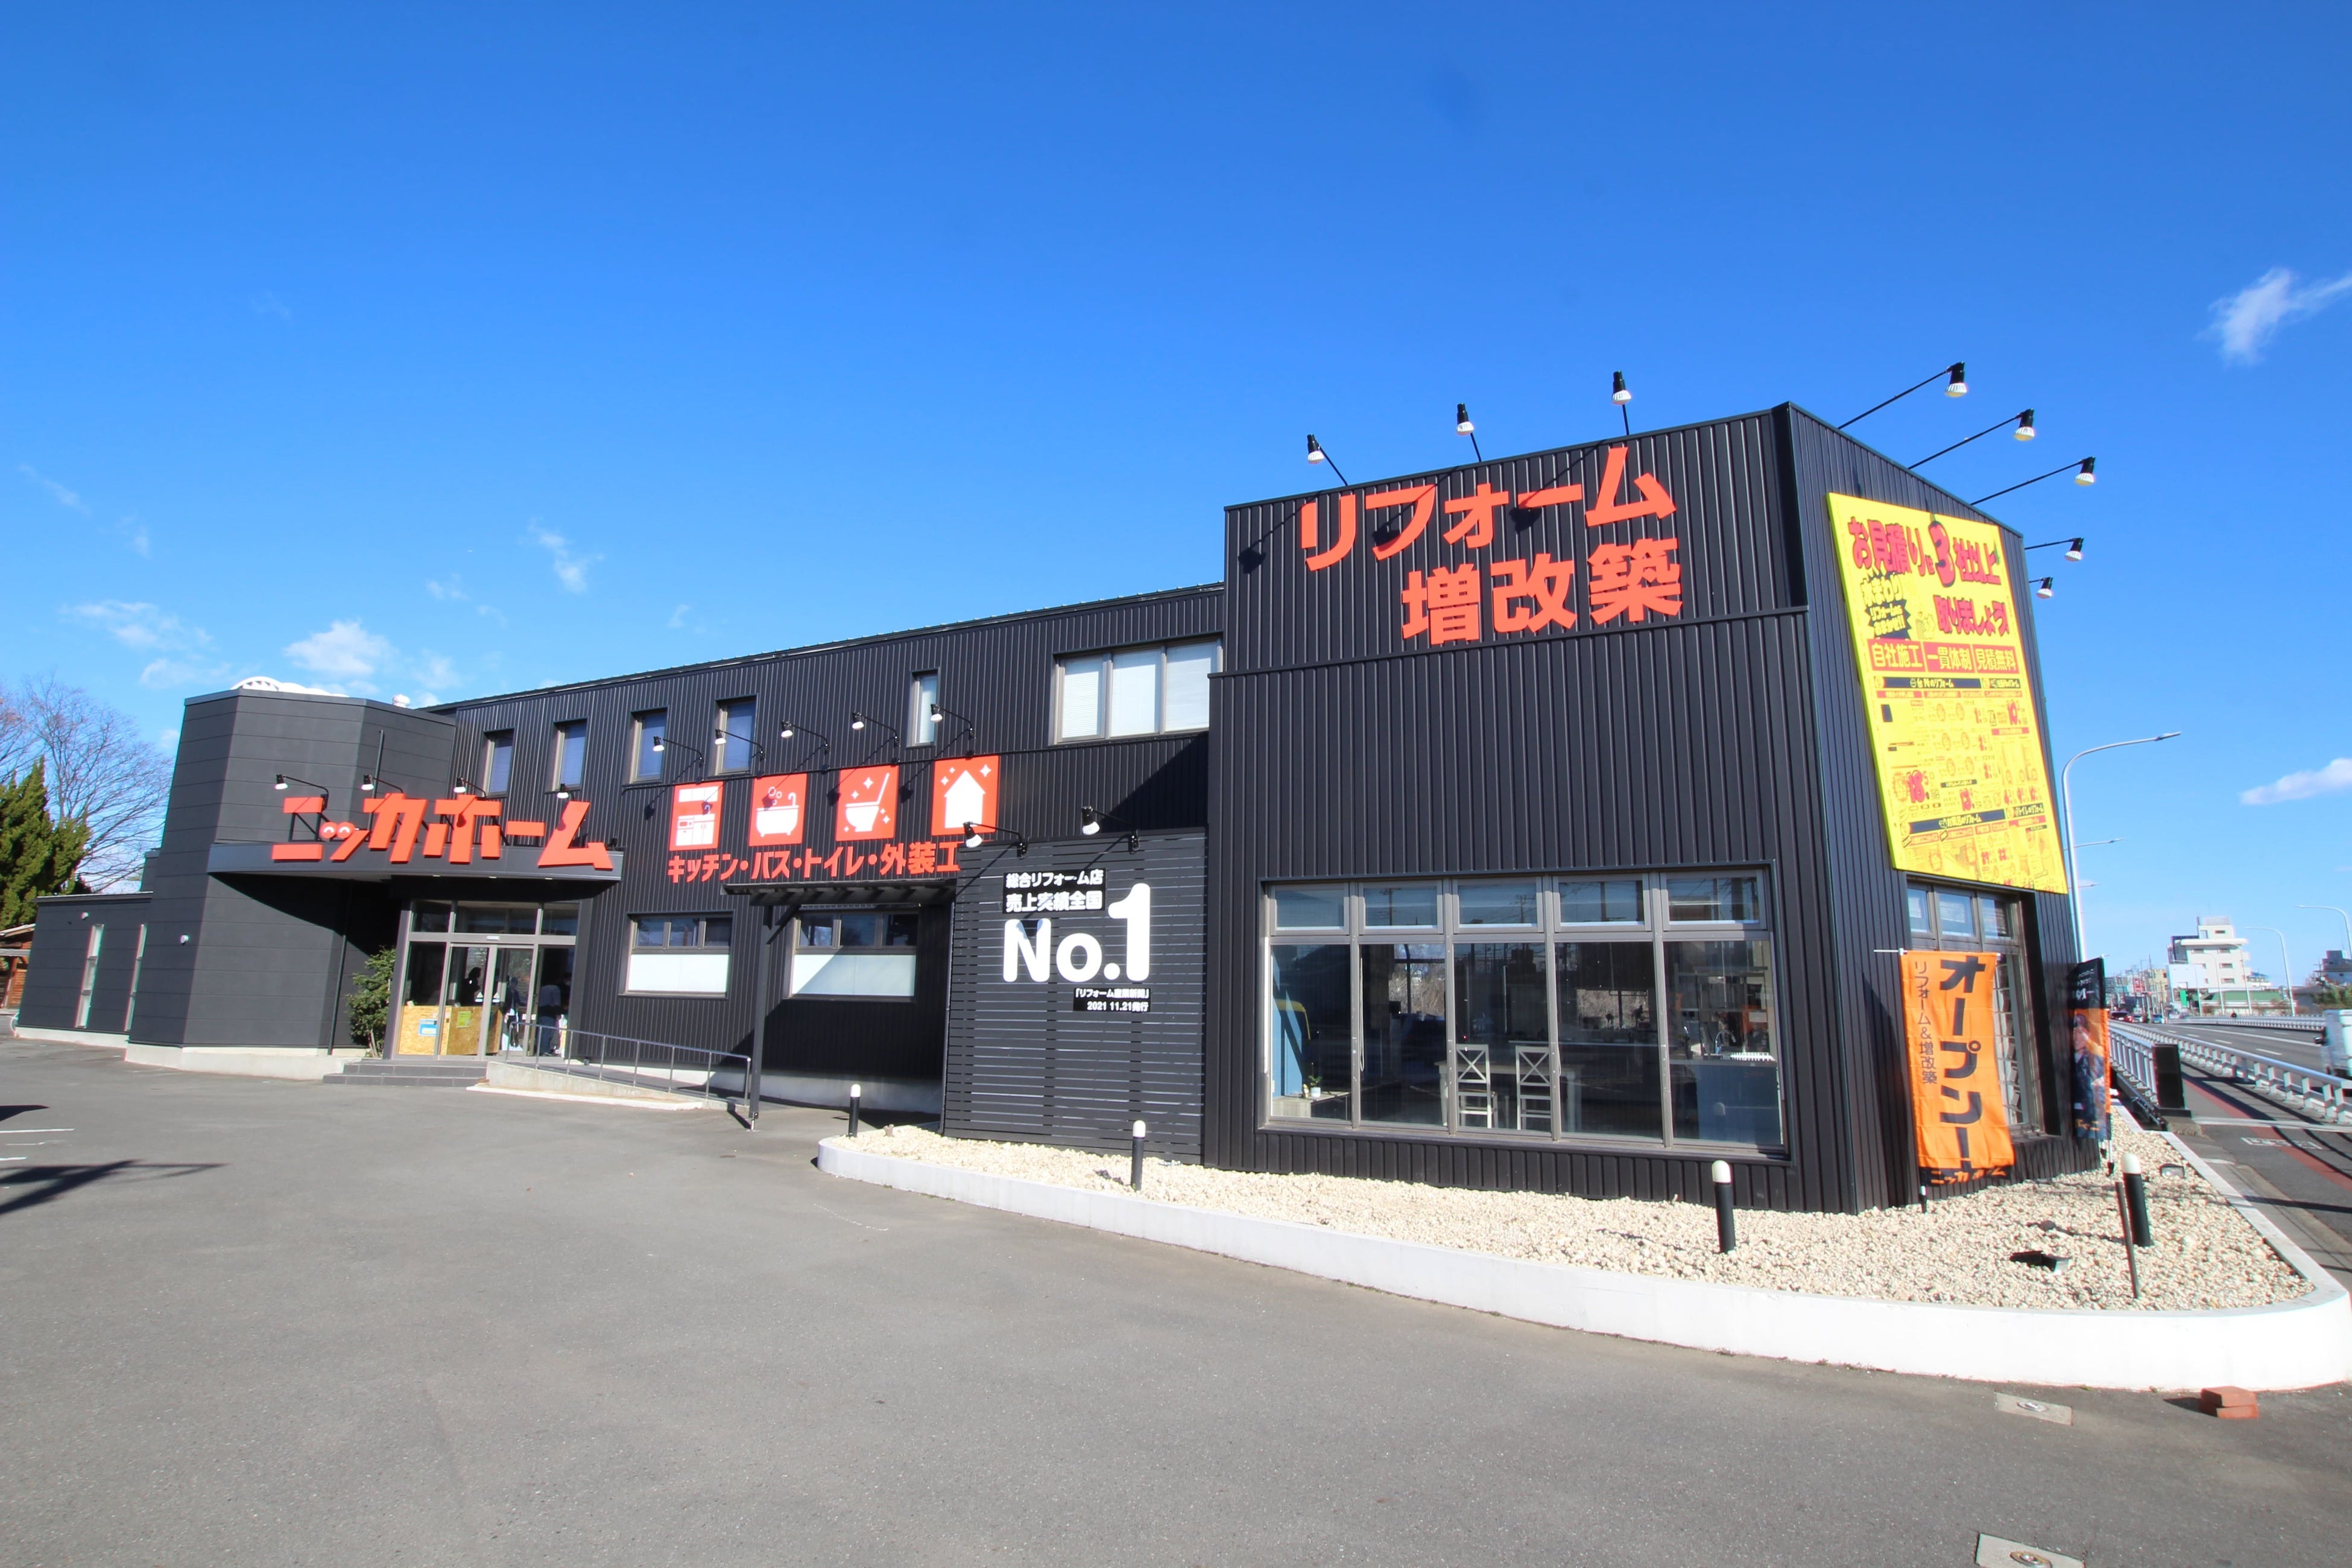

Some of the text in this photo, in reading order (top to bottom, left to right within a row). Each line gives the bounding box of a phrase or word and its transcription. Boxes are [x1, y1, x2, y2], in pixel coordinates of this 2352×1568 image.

[1301, 447, 1677, 571] リフォーム
[1402, 538, 1683, 645] 増改築
[1933, 594, 2009, 636] 取りましょう
[1871, 643, 1923, 668] 自社施工
[1927, 646, 1973, 671] 一貫体制
[1974, 648, 2017, 671] 見積無料
[271, 792, 613, 870] ニッカホーム
[667, 839, 994, 884] キッチン・バス・トイレ・外装工
[1005, 868, 1104, 889] 総合リフォーム店
[1005, 890, 1103, 913] 売上実績全国
[1003, 882, 1151, 982] No.1
[1087, 1001, 1107, 1011] 2021
[1914, 961, 1937, 1084] リフォーム&増改築
